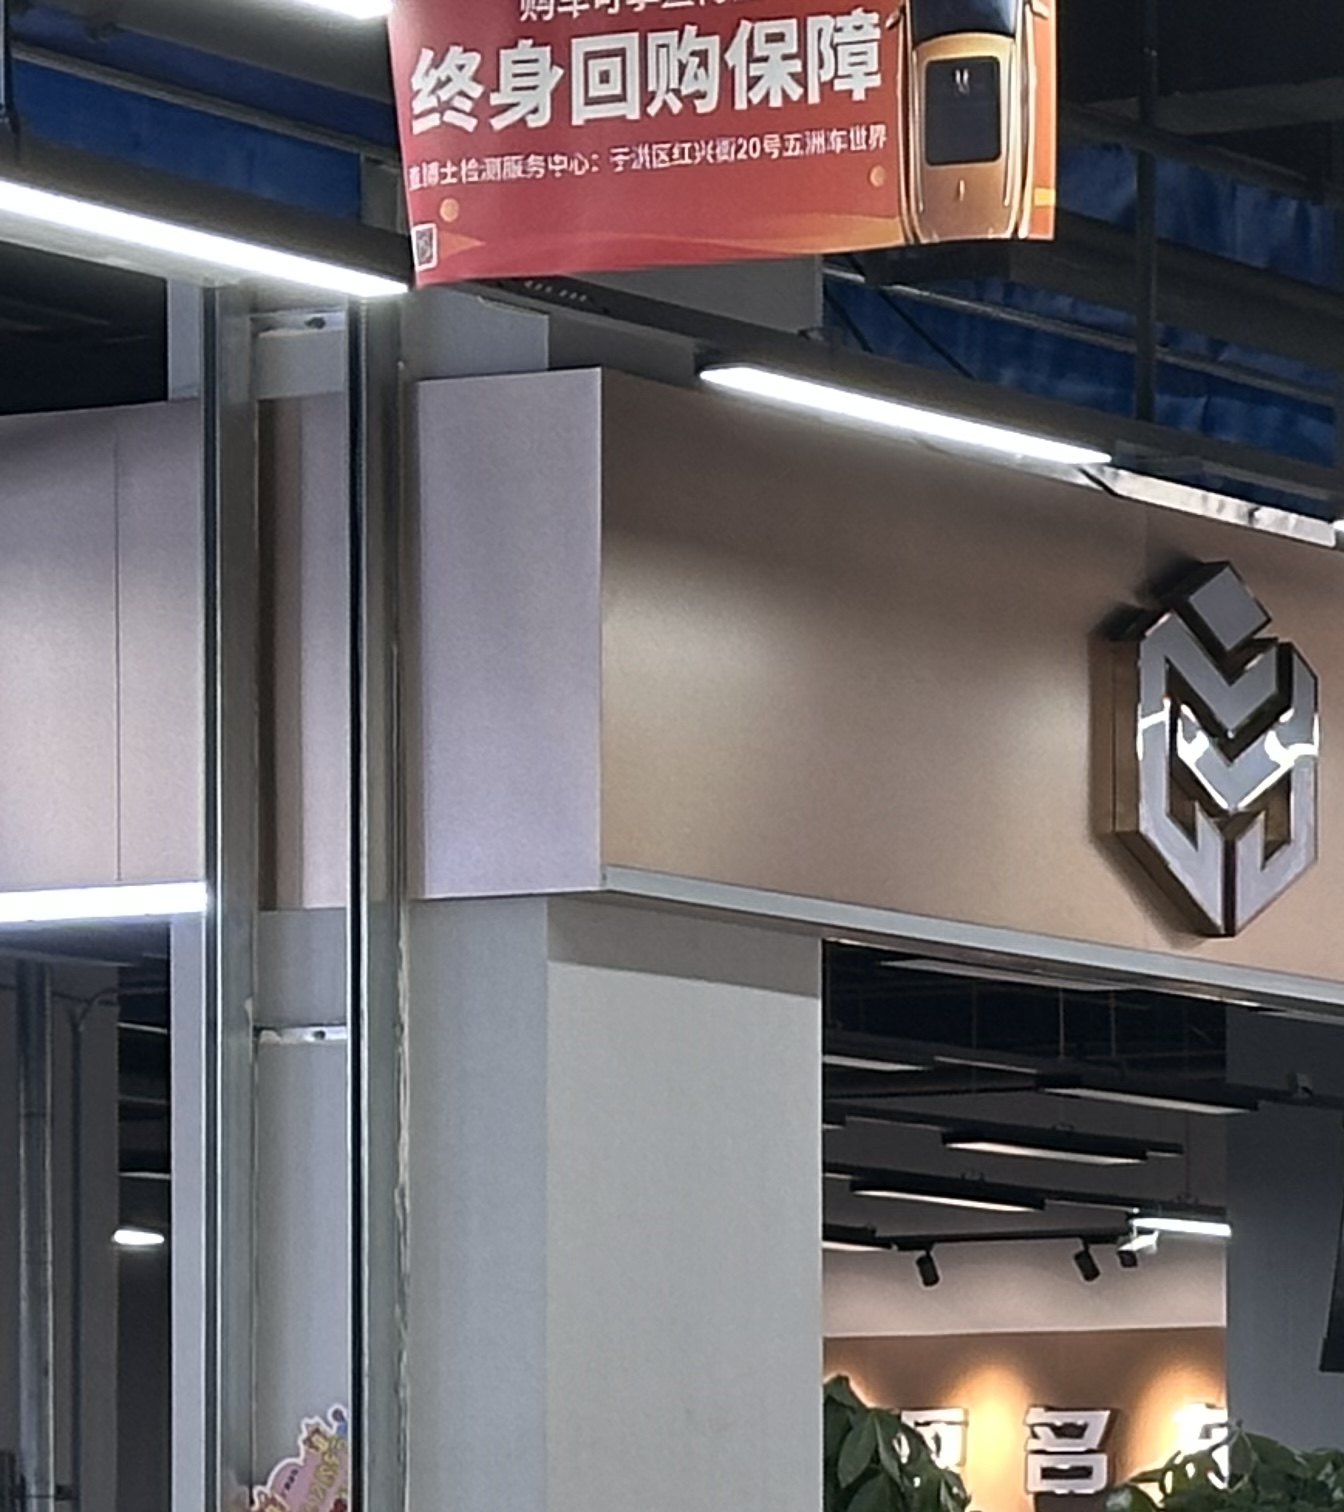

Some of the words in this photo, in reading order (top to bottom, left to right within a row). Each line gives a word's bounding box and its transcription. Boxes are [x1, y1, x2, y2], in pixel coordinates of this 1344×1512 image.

[411, 7, 882, 135] 终身回购保障
